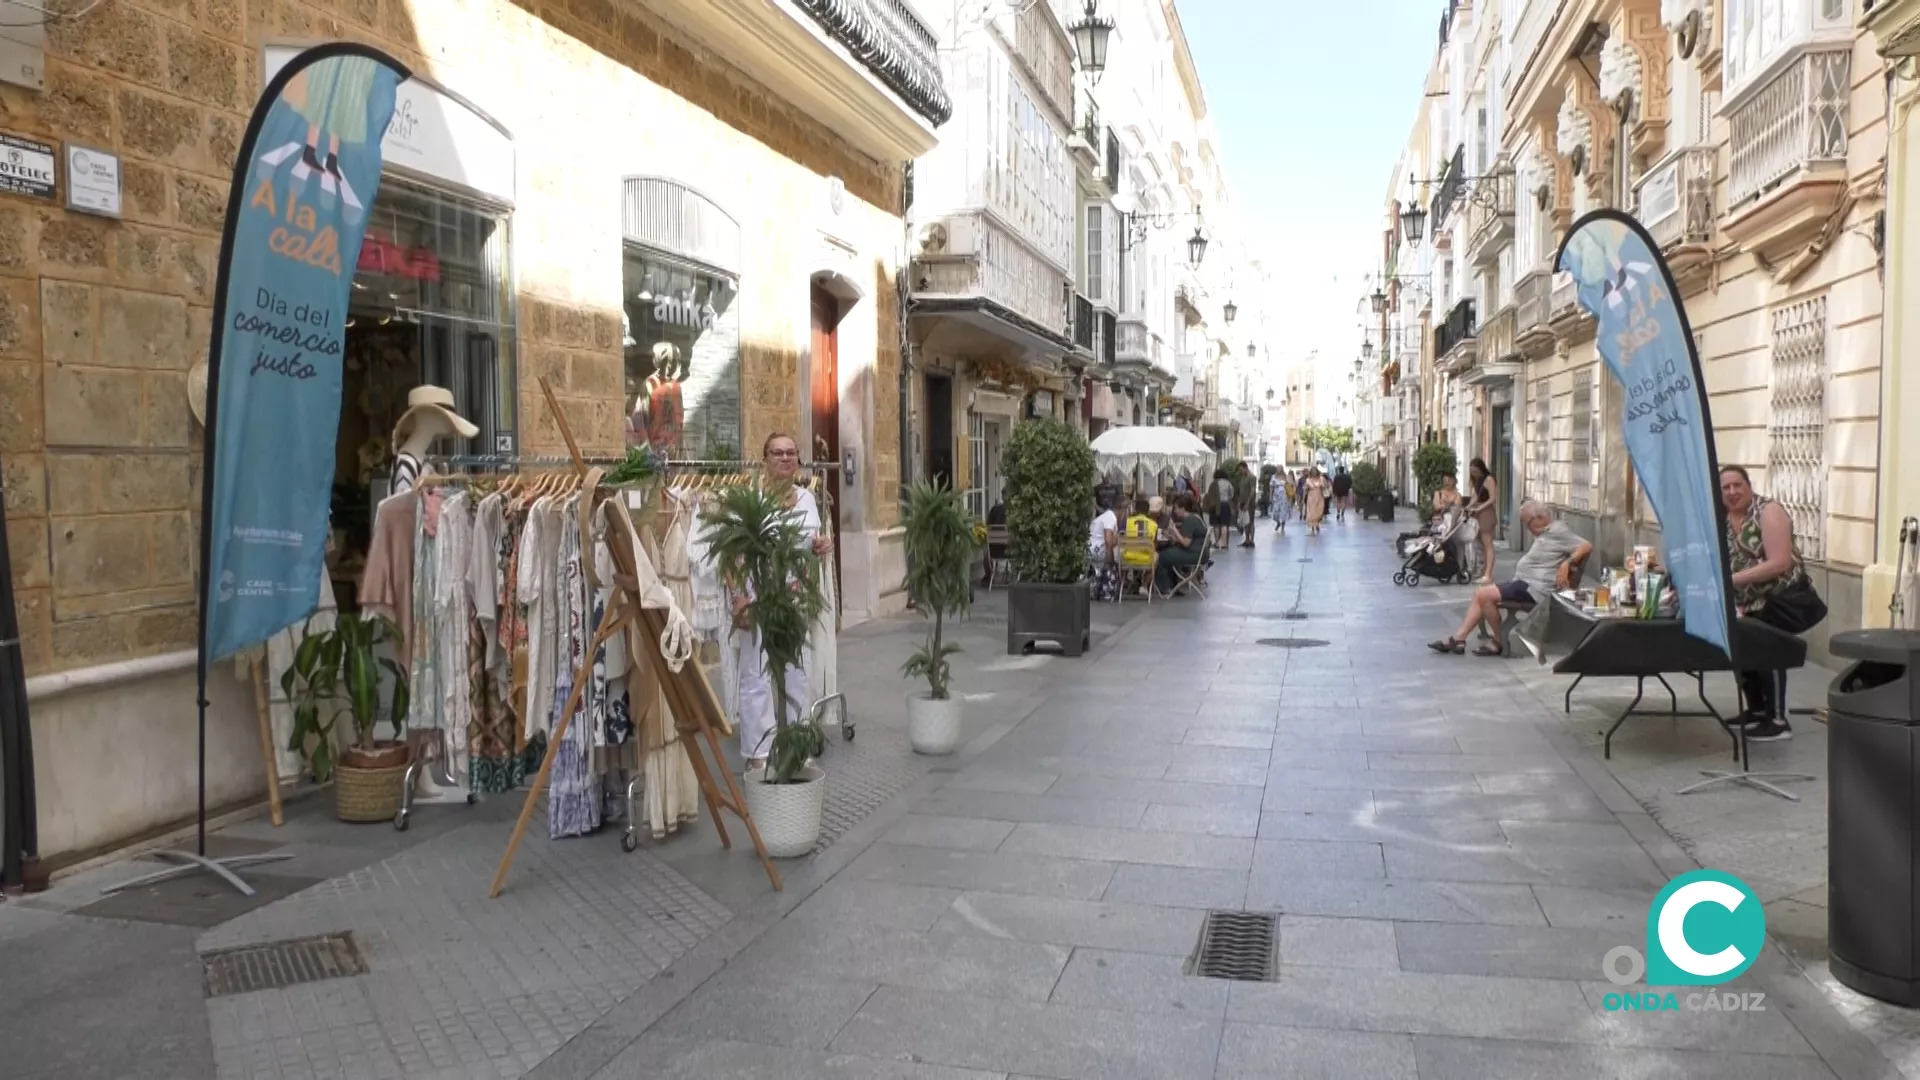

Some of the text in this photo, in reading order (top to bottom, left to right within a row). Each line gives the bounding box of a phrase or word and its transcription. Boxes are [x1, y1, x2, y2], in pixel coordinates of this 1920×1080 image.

[251, 178, 316, 232] A la
[294, 303, 330, 328] del
[653, 293, 714, 332] anika
[234, 311, 340, 355] comercio
[250, 344, 318, 379] justo
